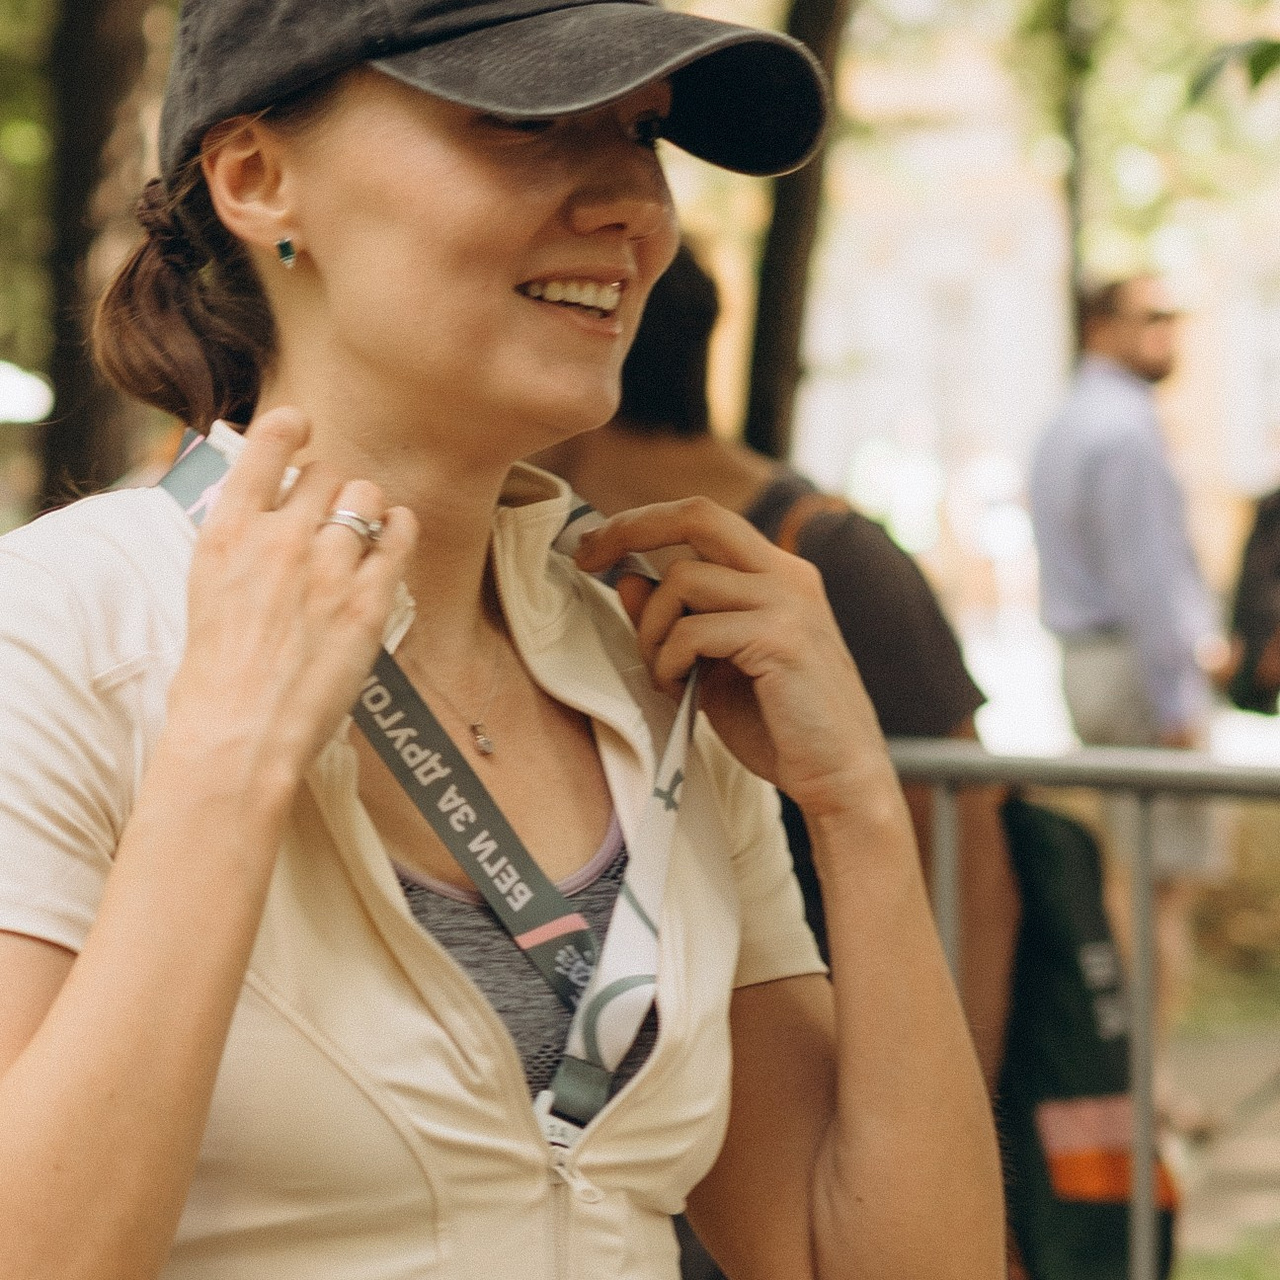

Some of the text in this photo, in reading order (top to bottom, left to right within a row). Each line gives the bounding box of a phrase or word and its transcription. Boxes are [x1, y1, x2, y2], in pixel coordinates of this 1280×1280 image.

[361, 675, 533, 912] БЕГИ ЗА ДРУГО
